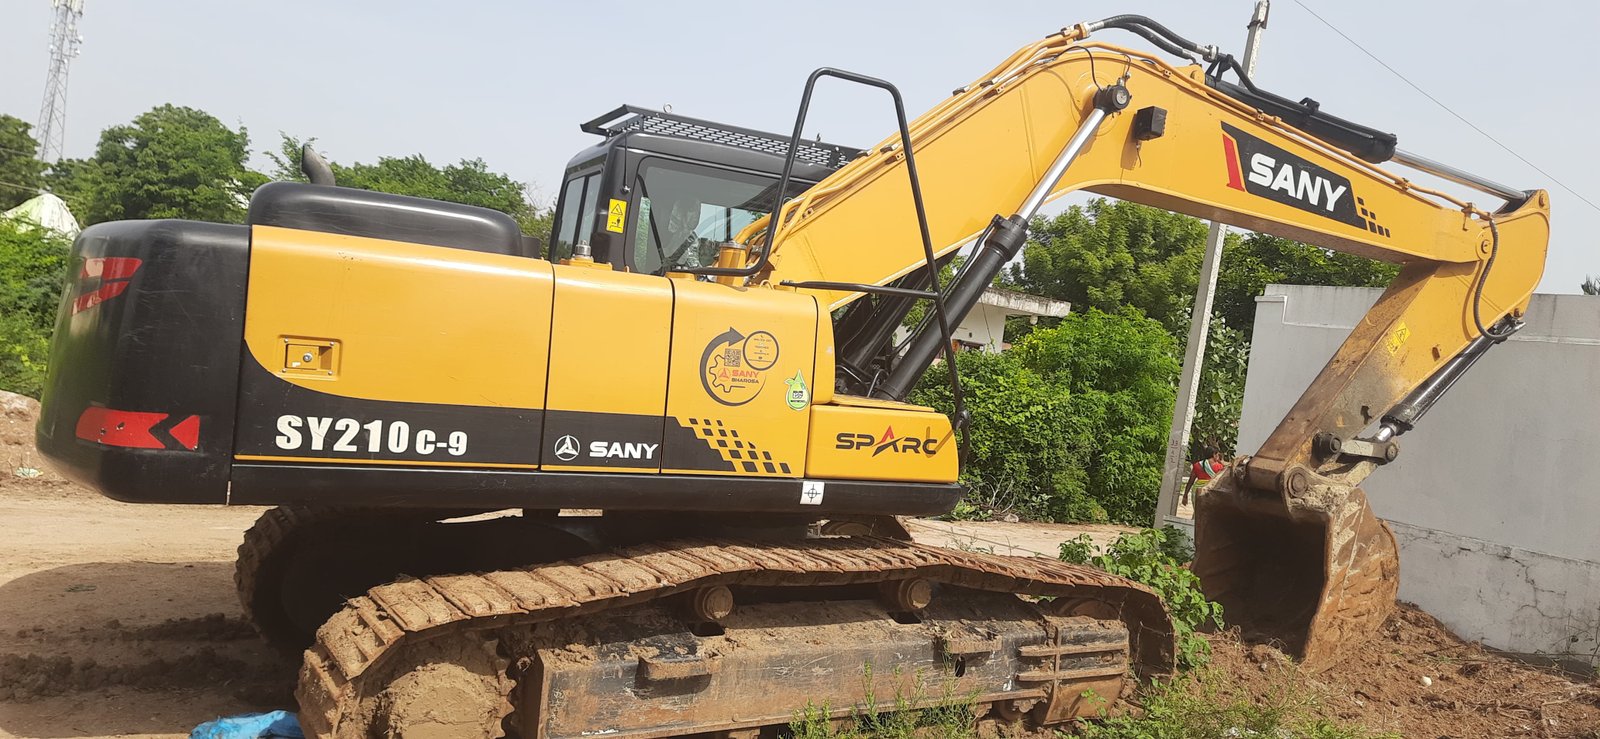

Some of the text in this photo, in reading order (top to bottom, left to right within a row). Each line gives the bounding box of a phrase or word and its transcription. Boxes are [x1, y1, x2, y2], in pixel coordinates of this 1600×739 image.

[1248, 153, 1347, 212] SANY
[732, 370, 759, 378] SANY
[589, 440, 659, 460] SANY
[836, 425, 937, 457] SPARC
